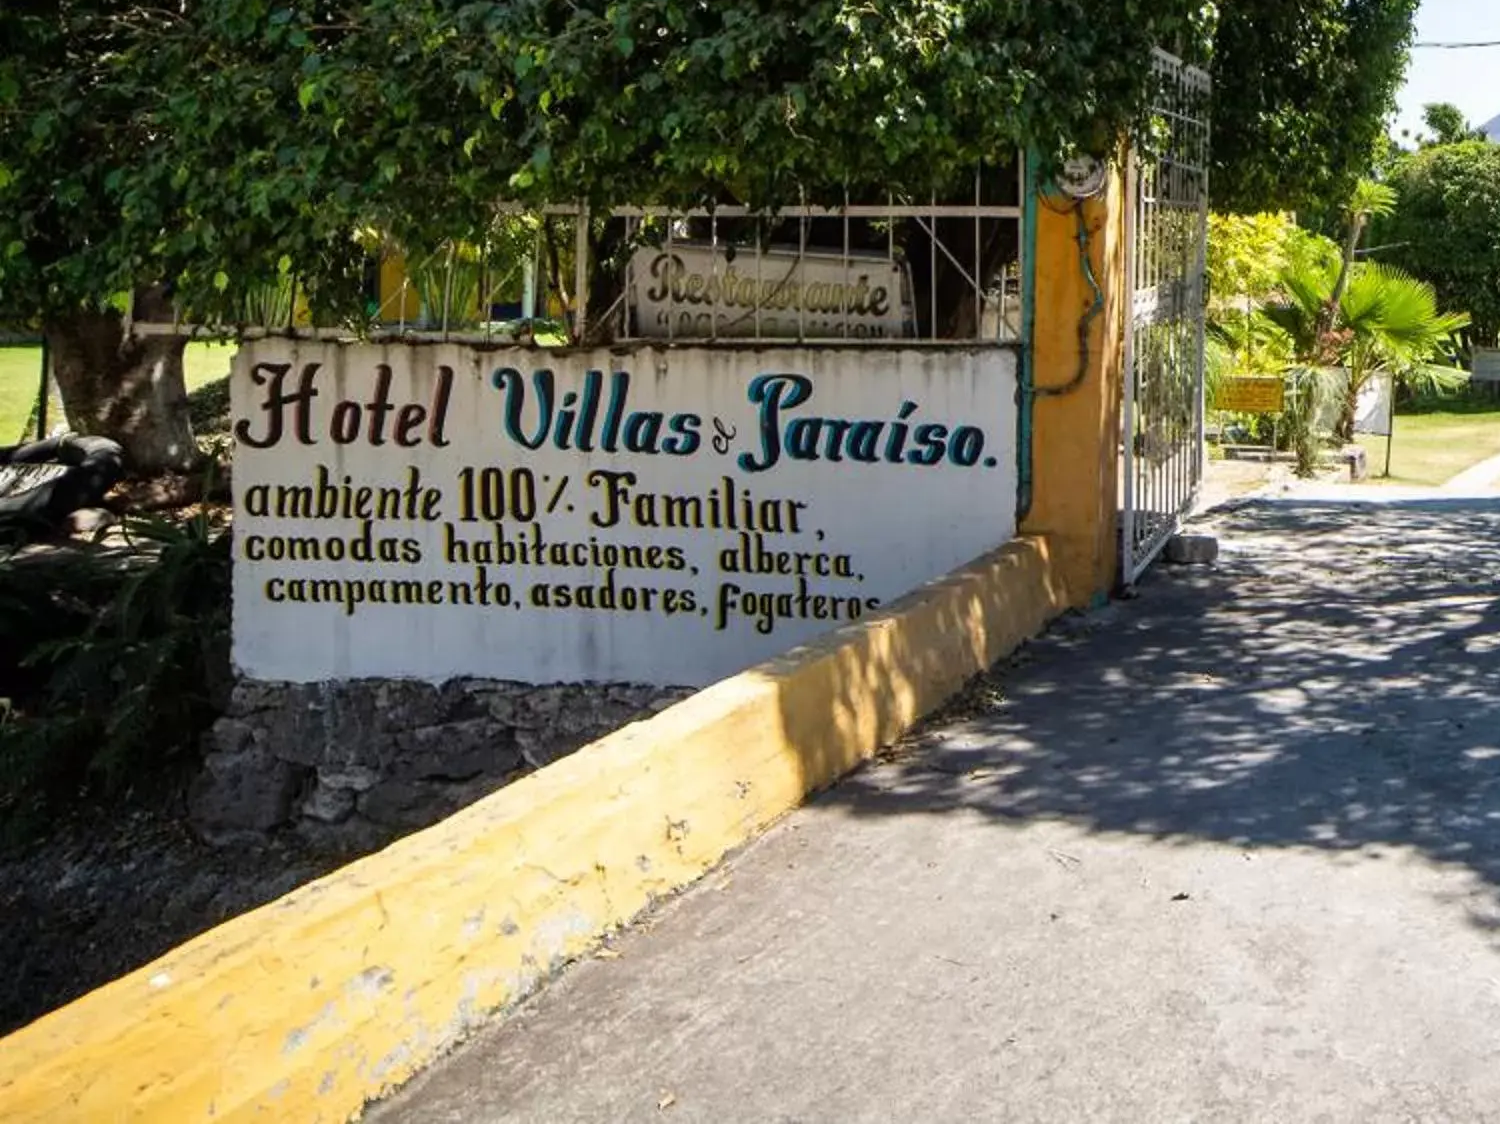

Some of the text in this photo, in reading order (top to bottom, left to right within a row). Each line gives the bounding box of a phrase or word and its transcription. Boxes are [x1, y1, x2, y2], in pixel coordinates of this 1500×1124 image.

[647, 253, 889, 316] Restaurante
[234, 363, 454, 448] Hotel
[492, 367, 702, 453] Villas
[737, 373, 998, 473] Paraíso.
[244, 464, 442, 522] ambiente
[586, 470, 825, 541] Familiar,
[245, 521, 865, 582] comodas habitaciones, alberca,
[264, 566, 522, 615] campamento,
[530, 567, 708, 618] asadores,
